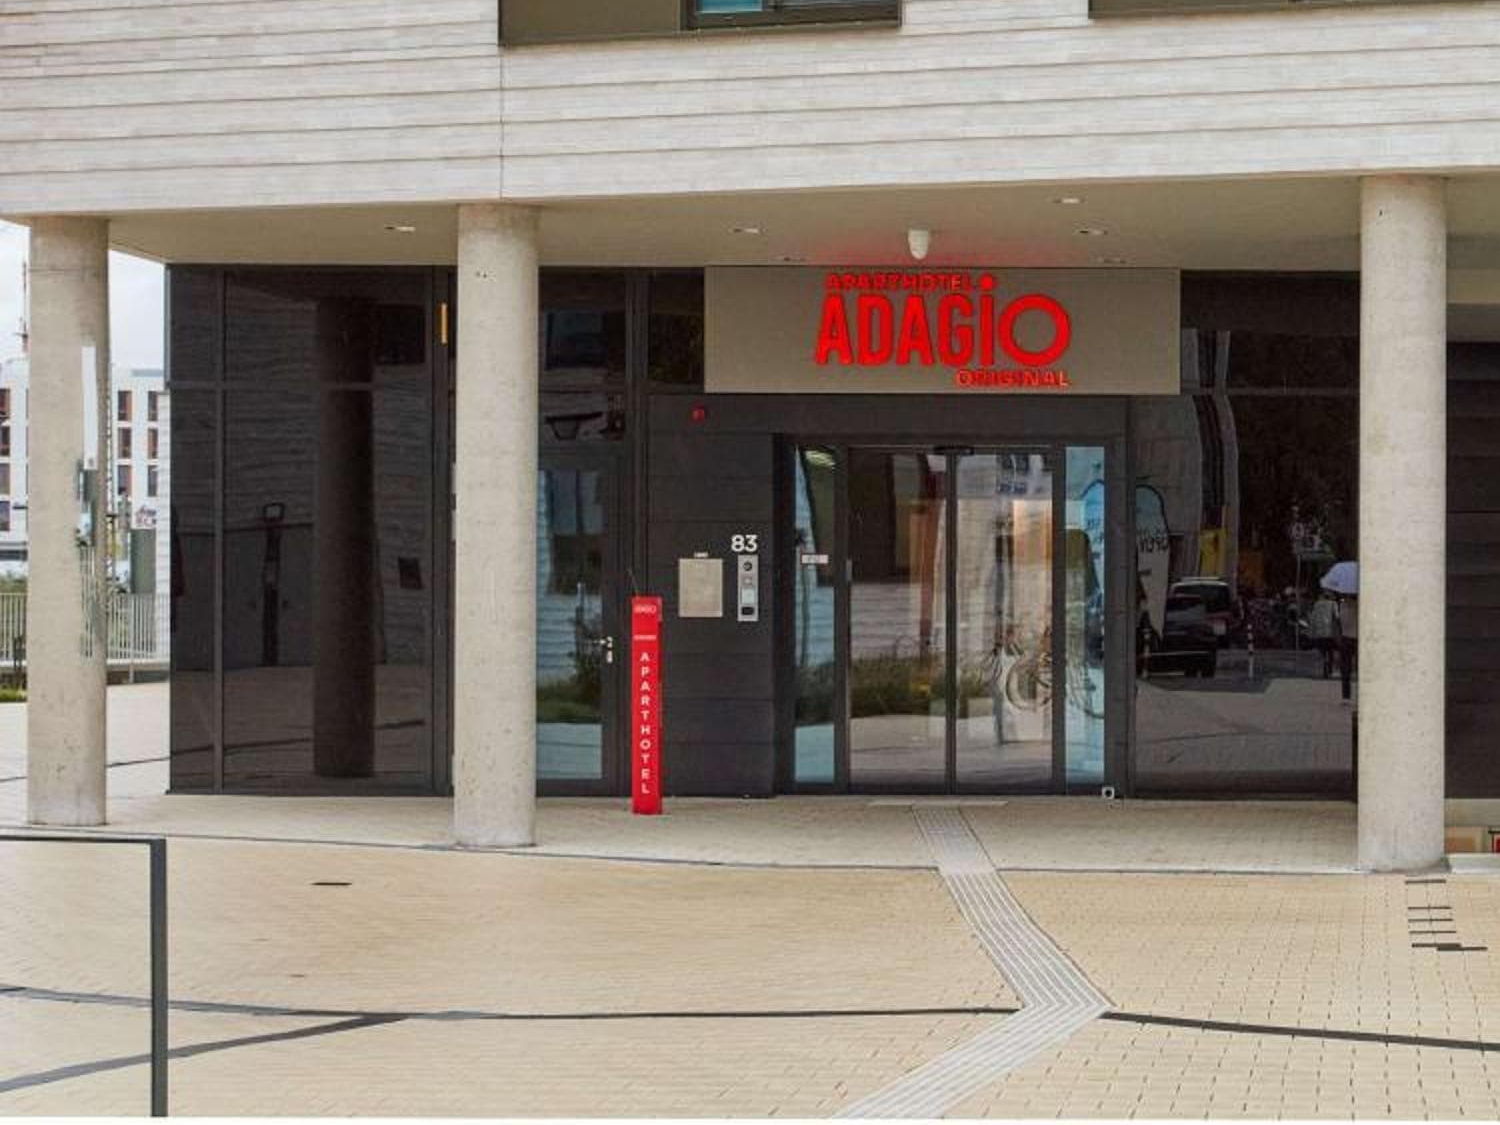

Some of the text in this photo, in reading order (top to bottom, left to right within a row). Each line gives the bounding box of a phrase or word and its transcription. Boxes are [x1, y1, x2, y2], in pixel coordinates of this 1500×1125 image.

[827, 274, 974, 292] APARTHOTEL
[956, 370, 1070, 388] ORIGINAL
[731, 534, 758, 552] 83
[639, 651, 651, 794] APARTHOTEL
